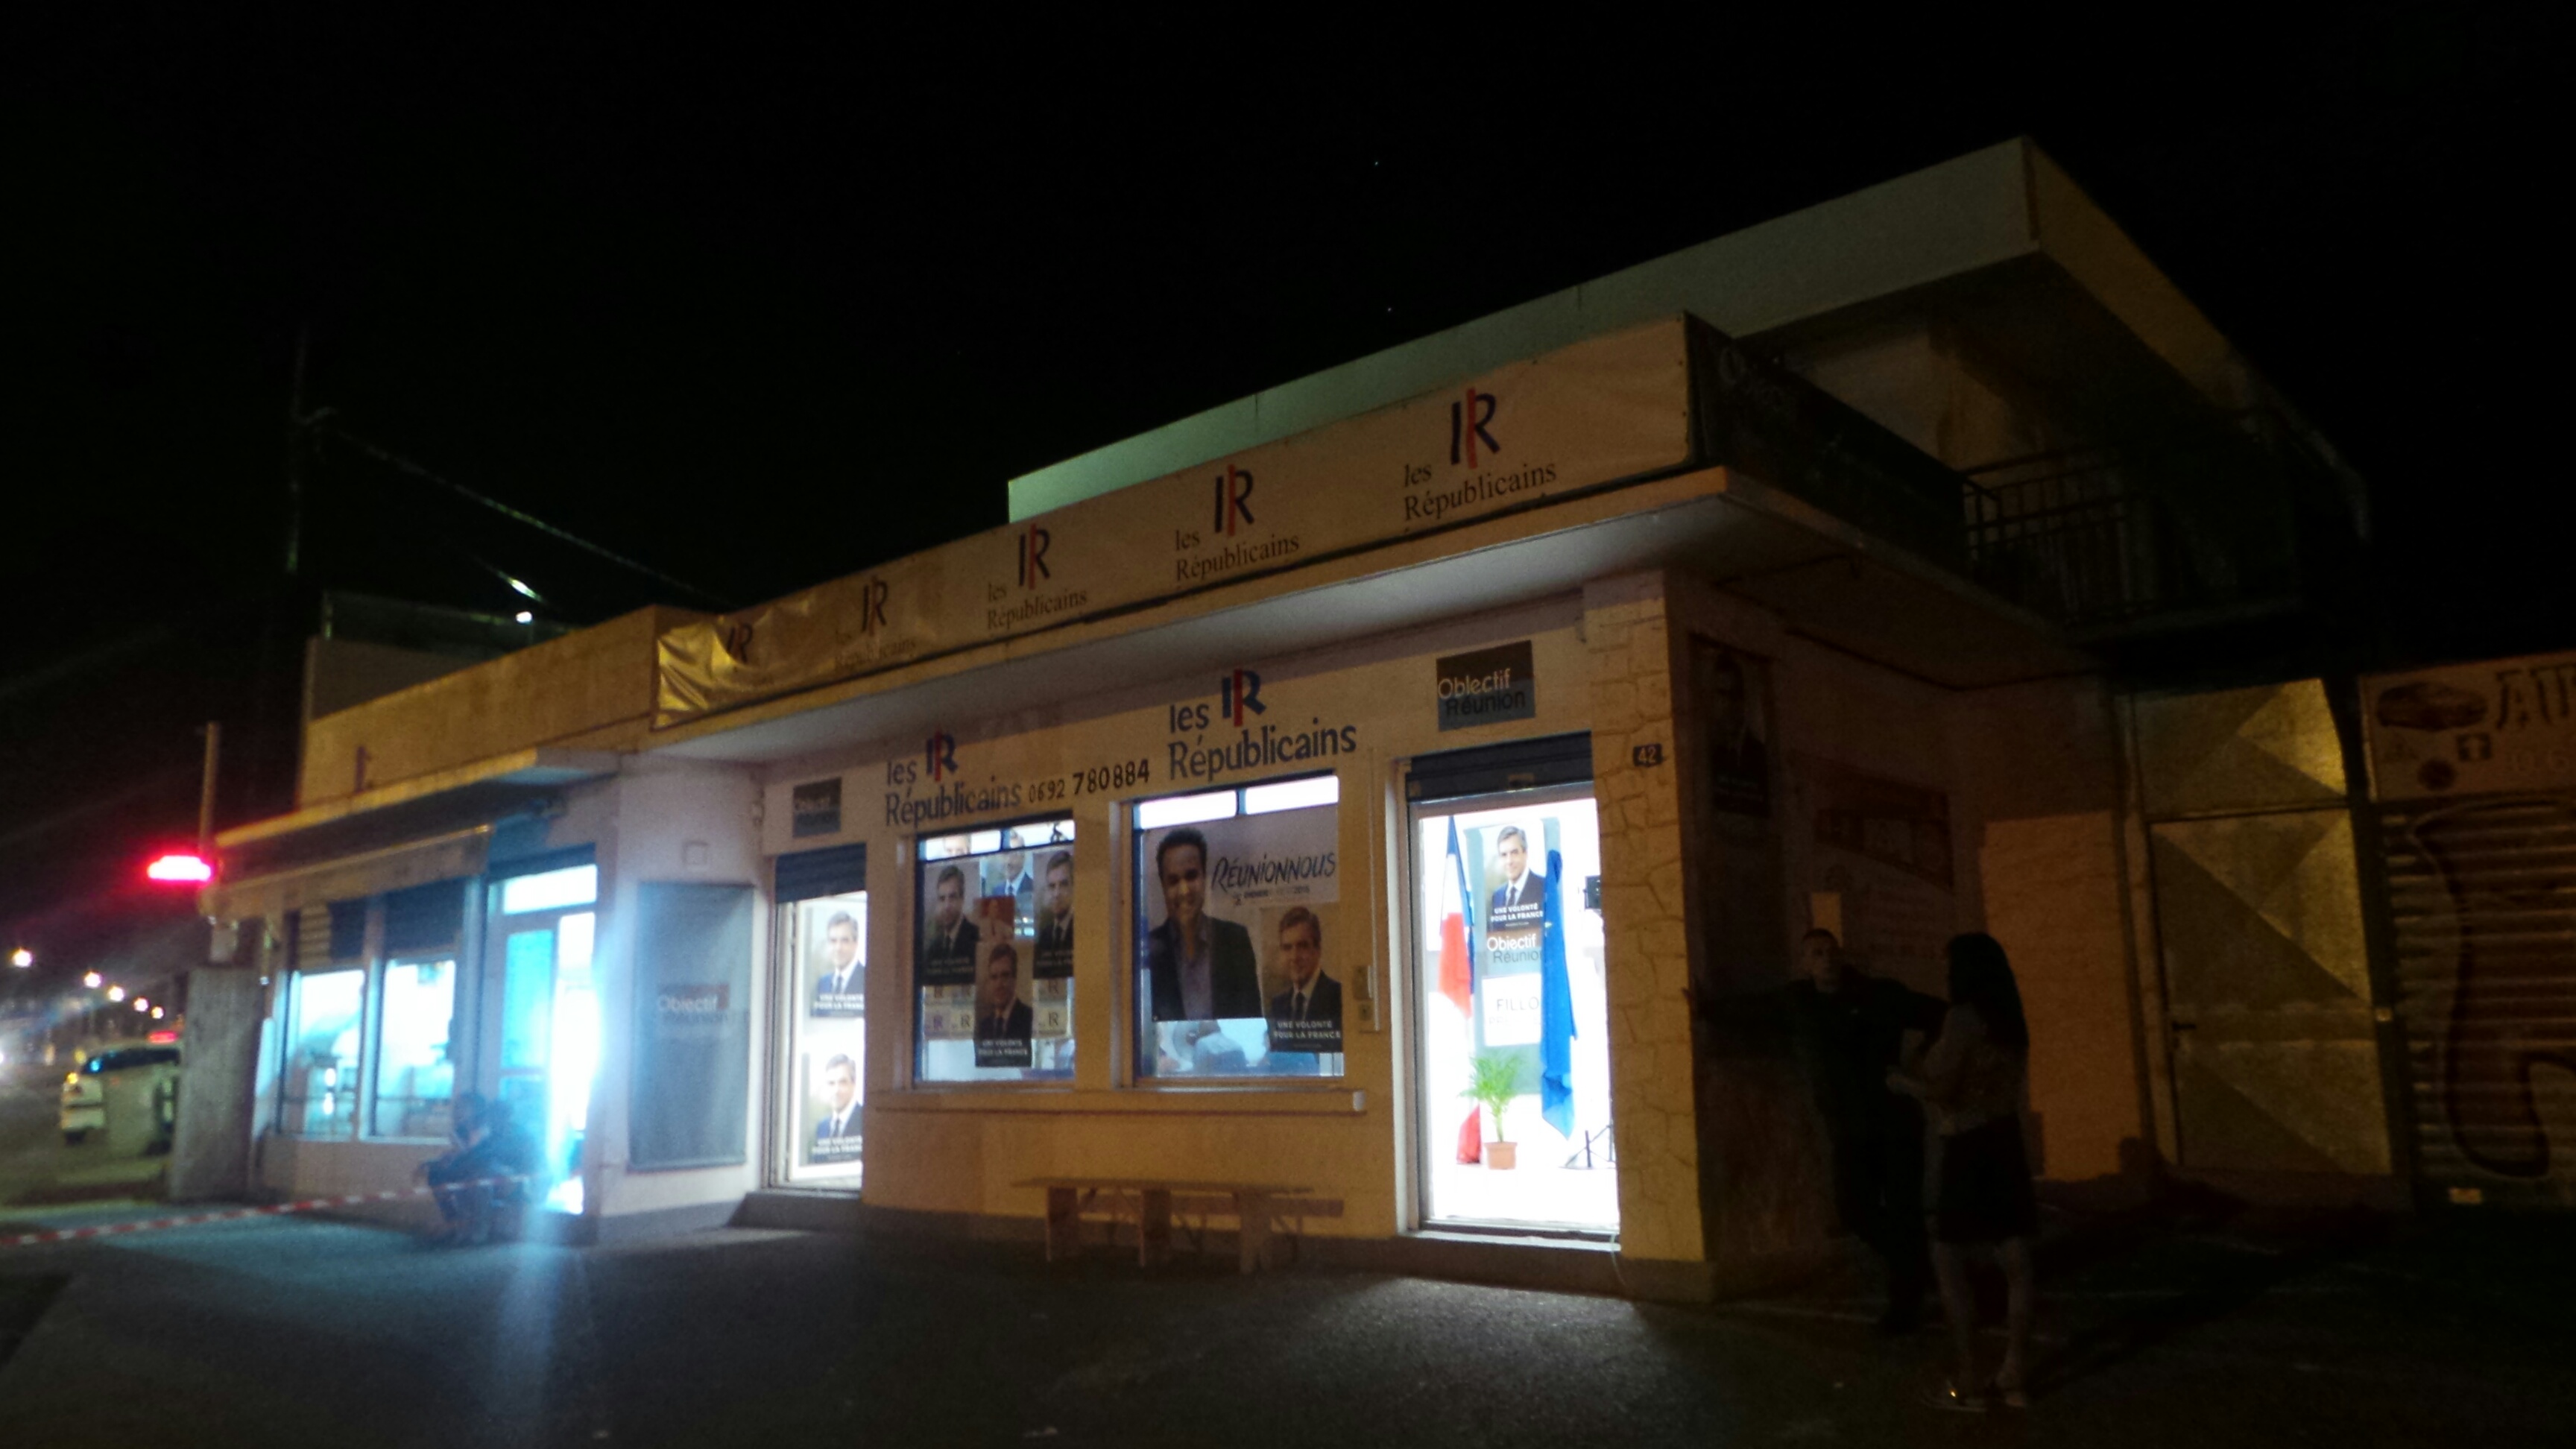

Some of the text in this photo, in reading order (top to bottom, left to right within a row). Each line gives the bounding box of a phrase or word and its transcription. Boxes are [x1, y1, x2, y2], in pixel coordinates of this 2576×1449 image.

[1404, 464, 1432, 487] les
[1404, 462, 1557, 520] Républicains
[1175, 530, 1201, 552] les
[1175, 533, 1300, 581] Républicains
[987, 583, 1008, 602] les
[987, 589, 1088, 630] Républicains
[1445, 689, 1526, 716] Réunion
[1169, 704, 1209, 734] les
[1168, 717, 1357, 782] Républicains
[1637, 745, 1656, 763] 42
[886, 759, 917, 786] les
[1028, 758, 1149, 804] 0692 780884
[885, 777, 1022, 827] Républicains
[1497, 997, 1540, 1011] FILLO
[1273, 1031, 1293, 1039] POUR
[1307, 1029, 1341, 1039] FRANCE
